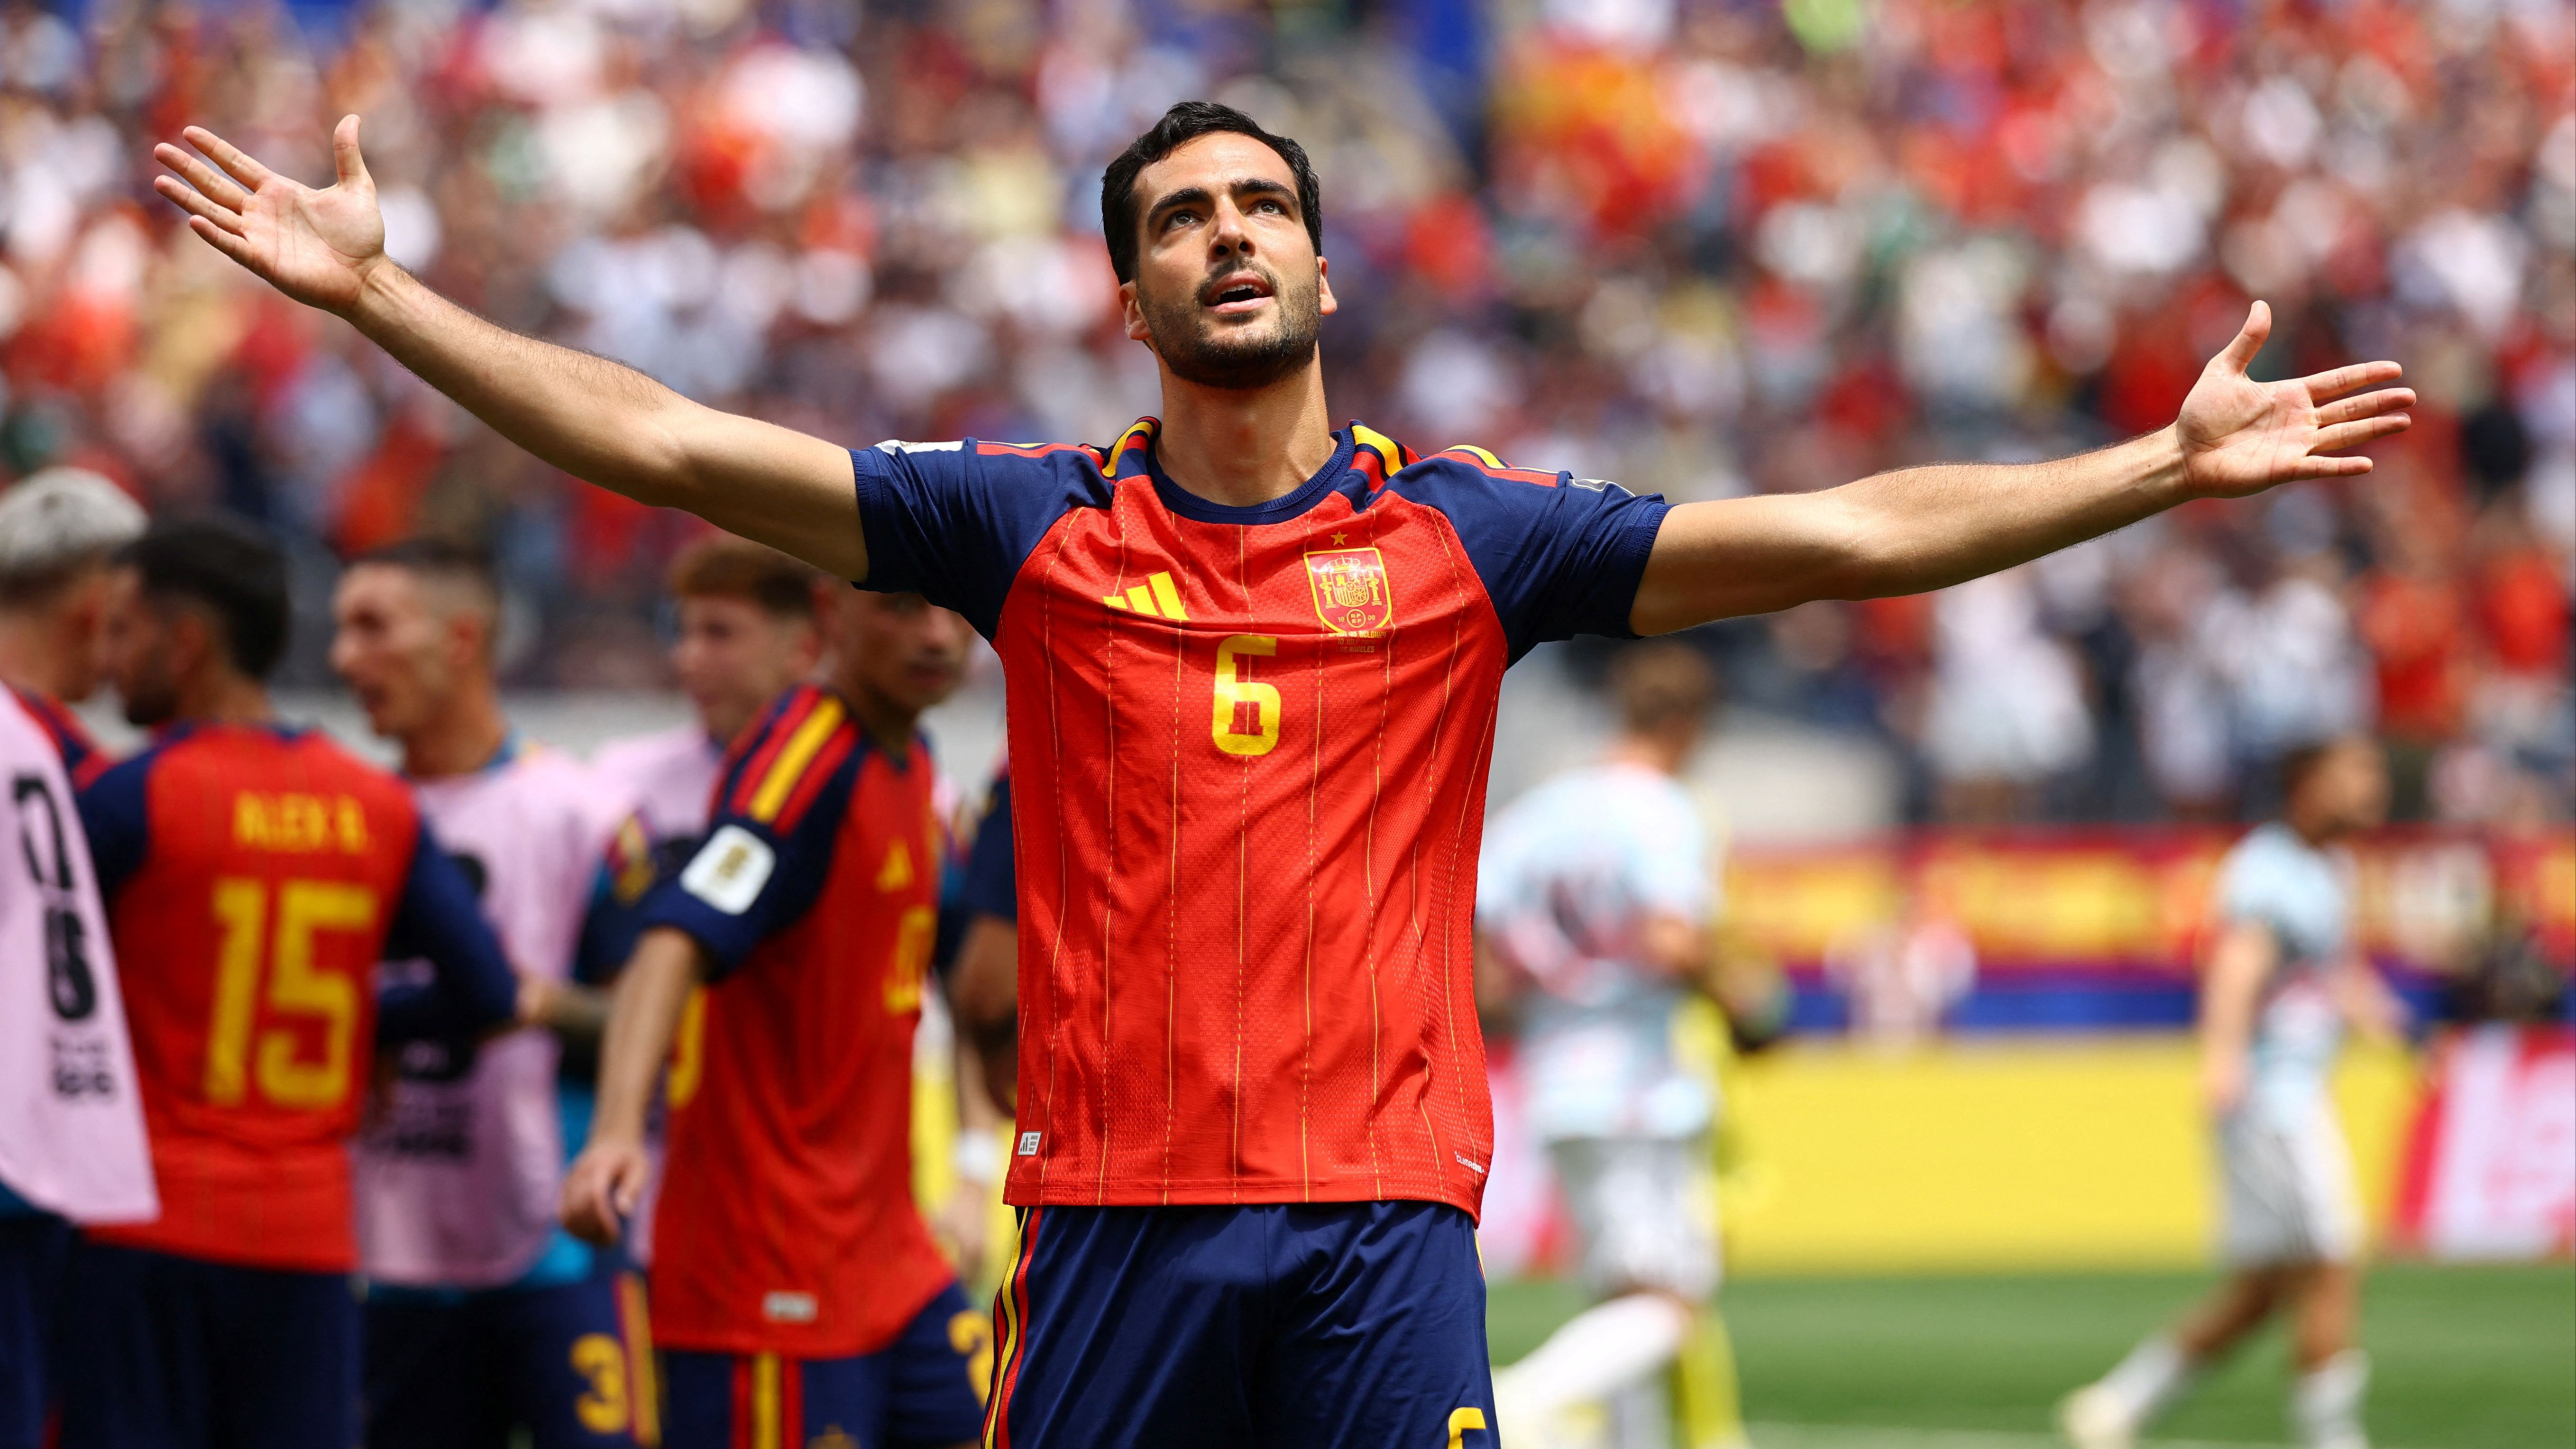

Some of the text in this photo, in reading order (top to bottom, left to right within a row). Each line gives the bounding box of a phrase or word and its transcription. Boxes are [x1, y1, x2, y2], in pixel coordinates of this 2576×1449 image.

[1211, 634, 1282, 756] 6
[1358, 630, 1386, 638] BELGIUM
[203, 875, 376, 1110] 15
